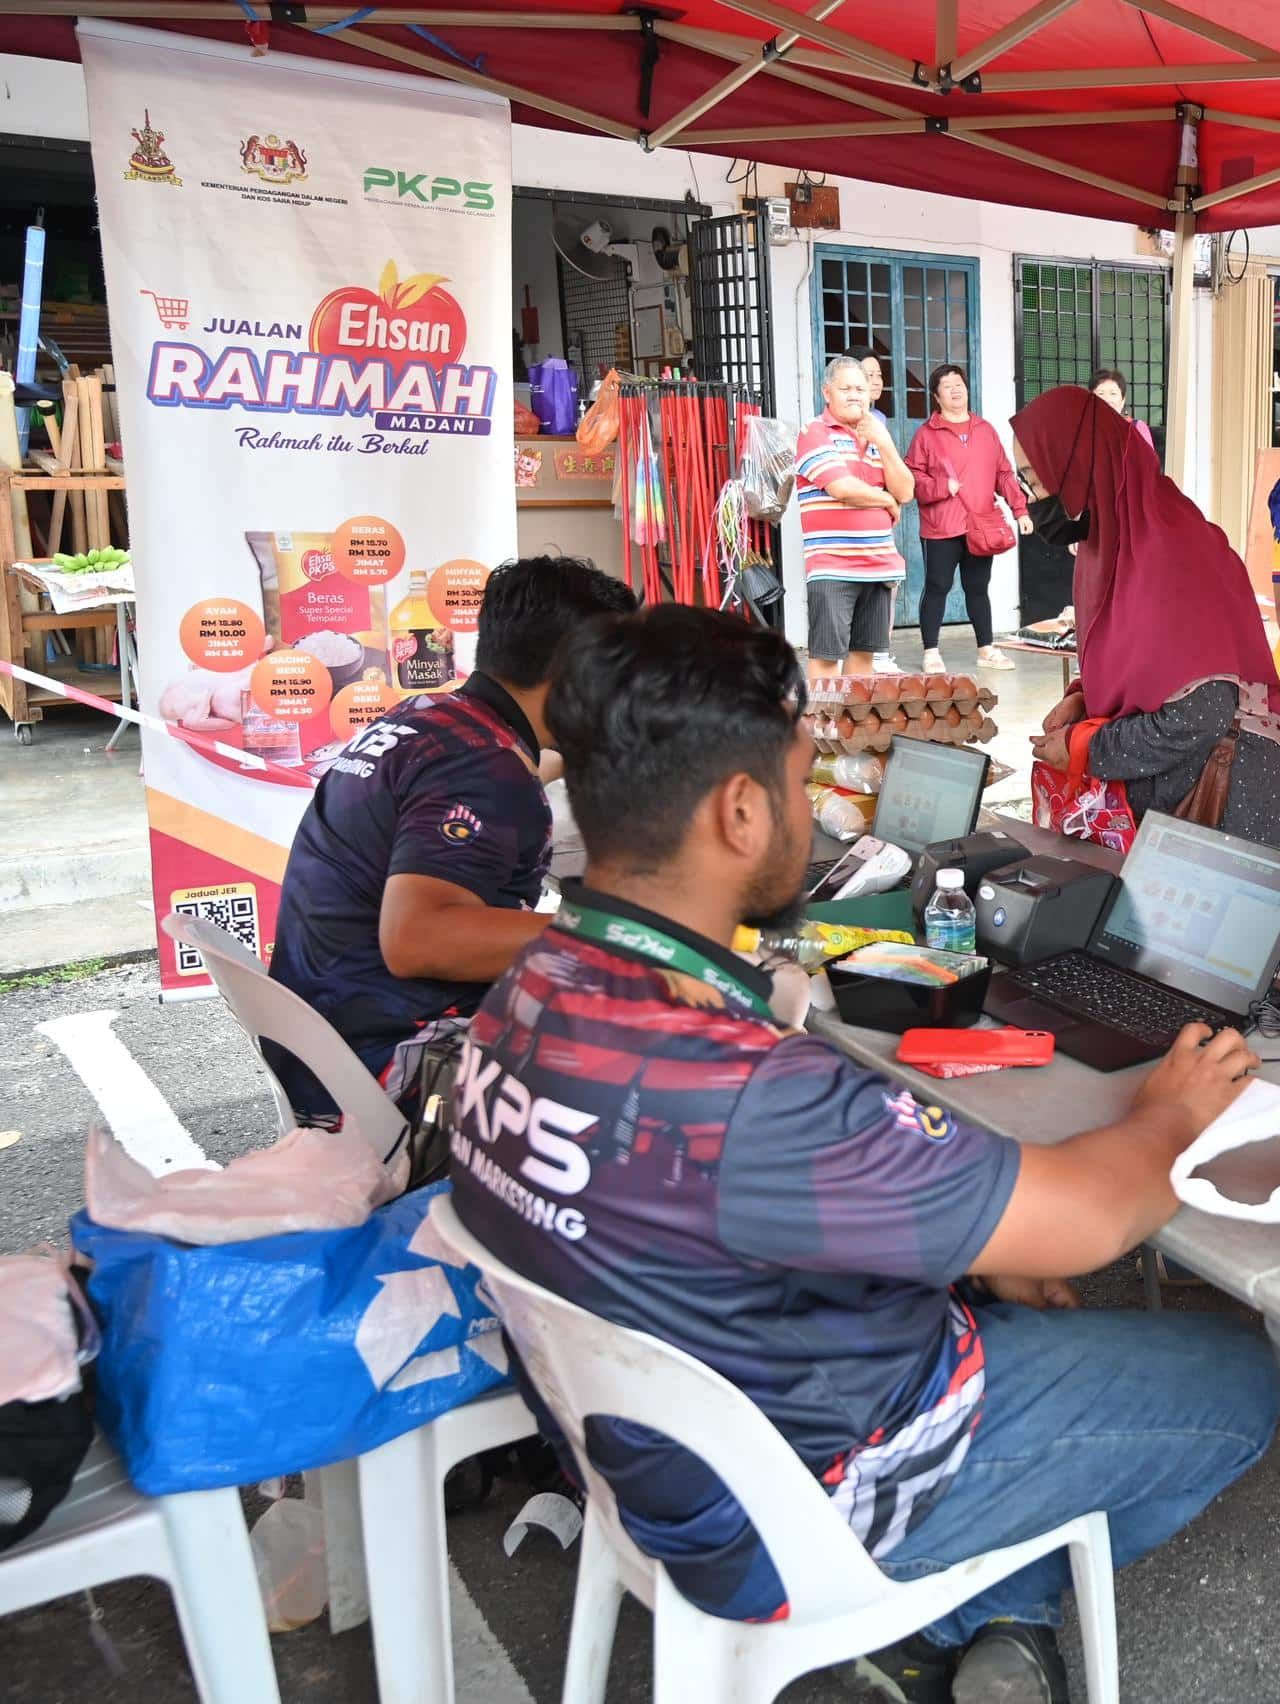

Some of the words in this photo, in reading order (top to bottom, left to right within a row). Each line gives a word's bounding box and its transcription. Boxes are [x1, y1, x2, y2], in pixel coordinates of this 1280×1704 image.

[363, 167, 495, 210] PKPS
[241, 193, 256, 201] DAN
[203, 317, 302, 340] JUALAN
[337, 301, 451, 354] Ehsan
[149, 343, 494, 417] RAHMAH
[389, 416, 475, 433] MADANI
[234, 426, 323, 451] Rahmah
[326, 432, 353, 452] itu
[357, 433, 429, 456] Berkat
[348, 549, 364, 557] RM
[367, 549, 391, 557] 13.00
[352, 568, 368, 576] RM
[307, 591, 345, 604] Beras
[298, 606, 322, 616] Super
[324, 605, 354, 616] Special
[306, 614, 347, 624] Tempatan
[200, 630, 216, 638] RM
[407, 669, 443, 680] Masak
[288, 688, 316, 696] 10.00
[184, 888, 218, 899] Jadual
[220, 887, 237, 896] JER
[604, 922, 676, 961] PKPS
[702, 967, 753, 1007] PKPS
[470, 1148, 588, 1242] MARKETING
